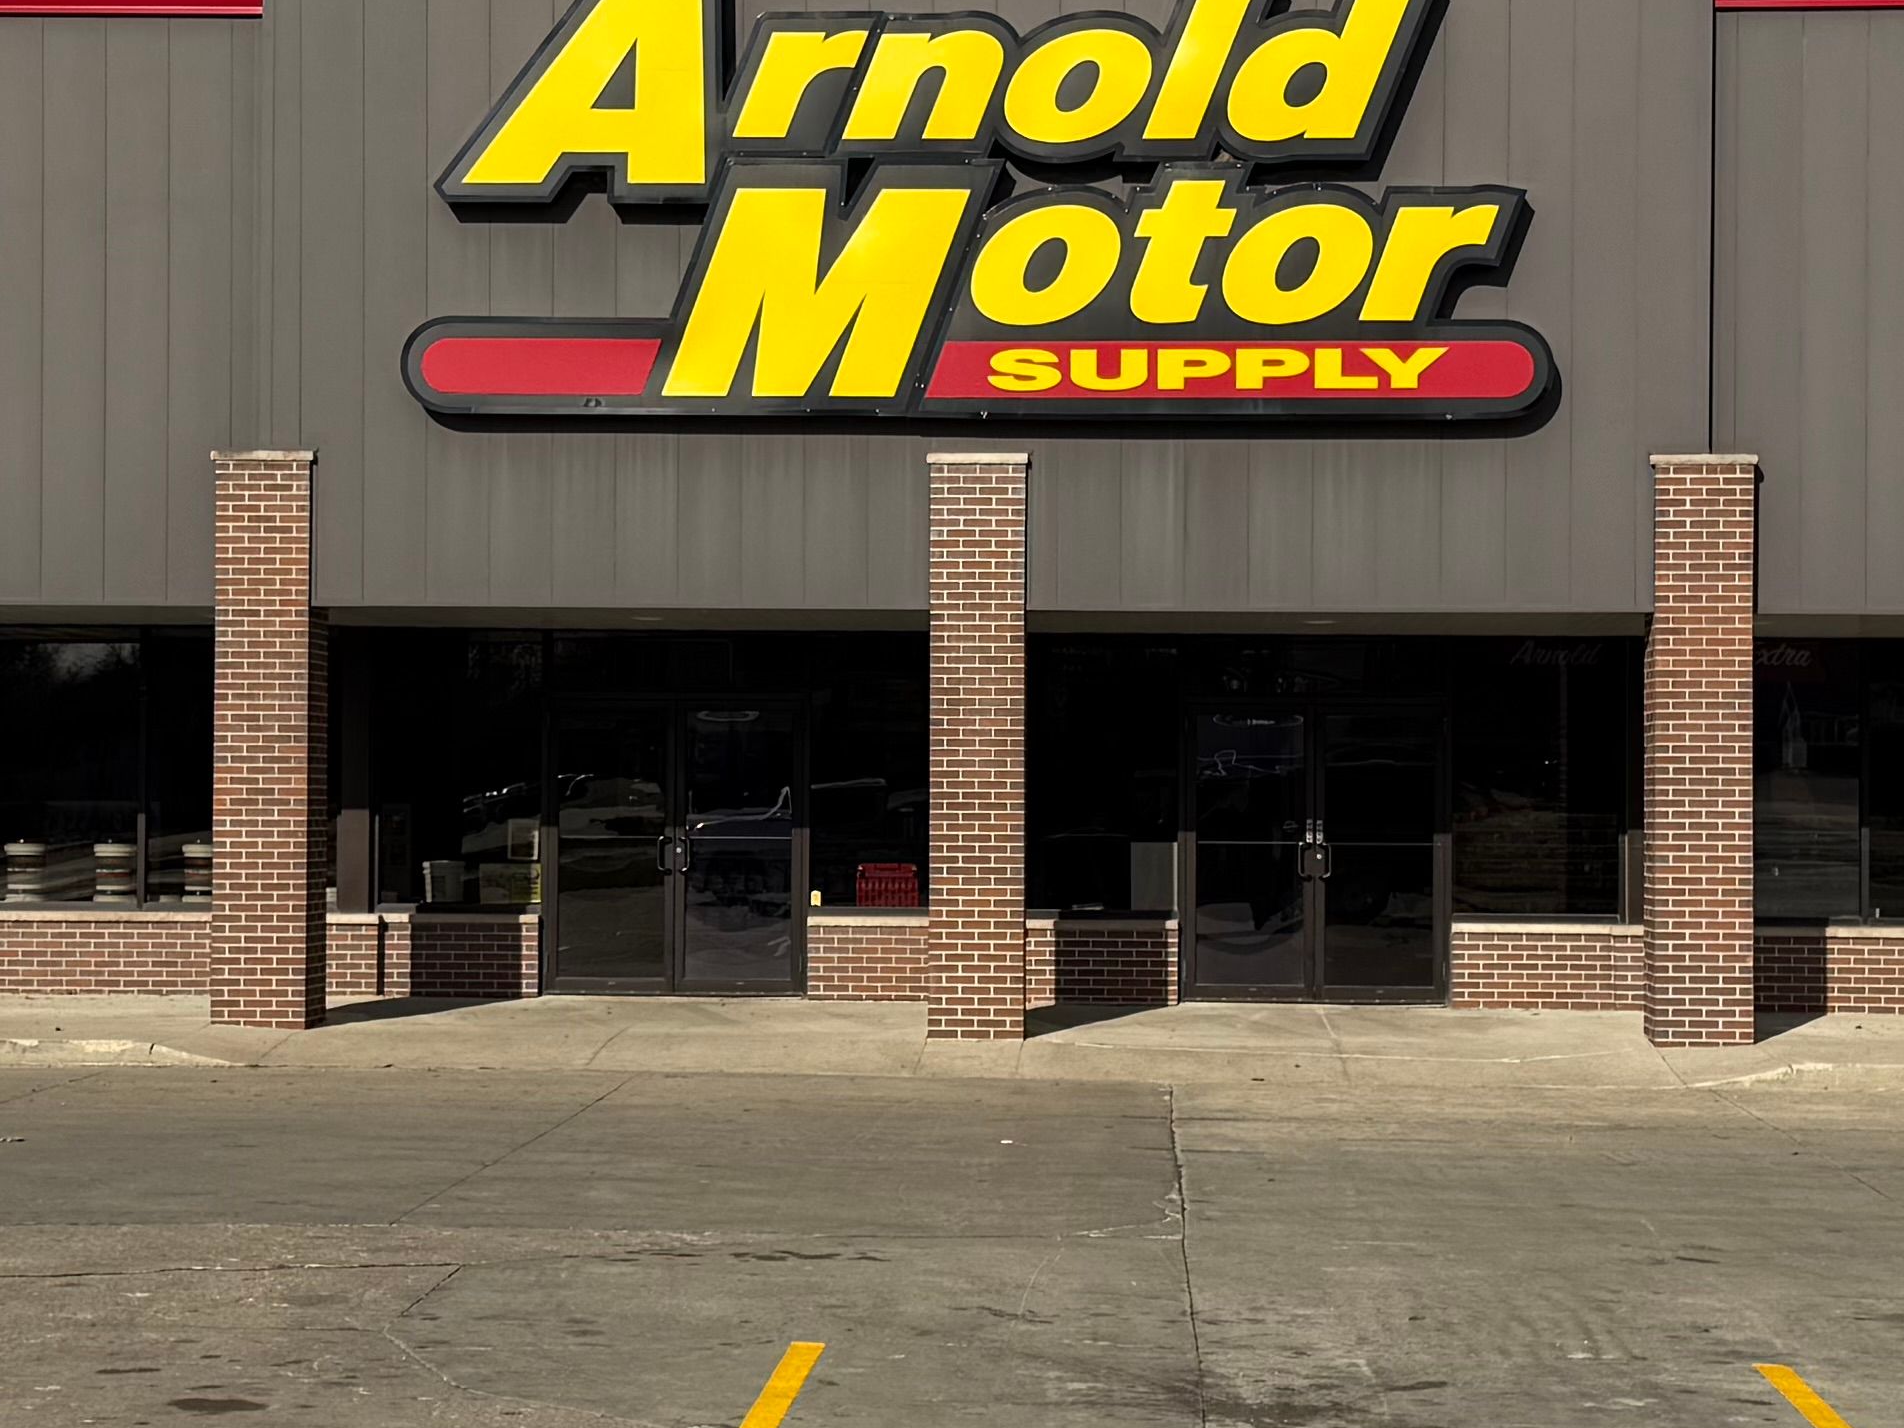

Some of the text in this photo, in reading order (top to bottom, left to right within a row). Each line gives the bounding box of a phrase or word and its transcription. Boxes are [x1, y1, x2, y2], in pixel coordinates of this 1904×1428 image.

[661, 180, 1500, 399] Motor
[986, 346, 1447, 392] SUPPLY
[1754, 641, 1813, 667] xtra
